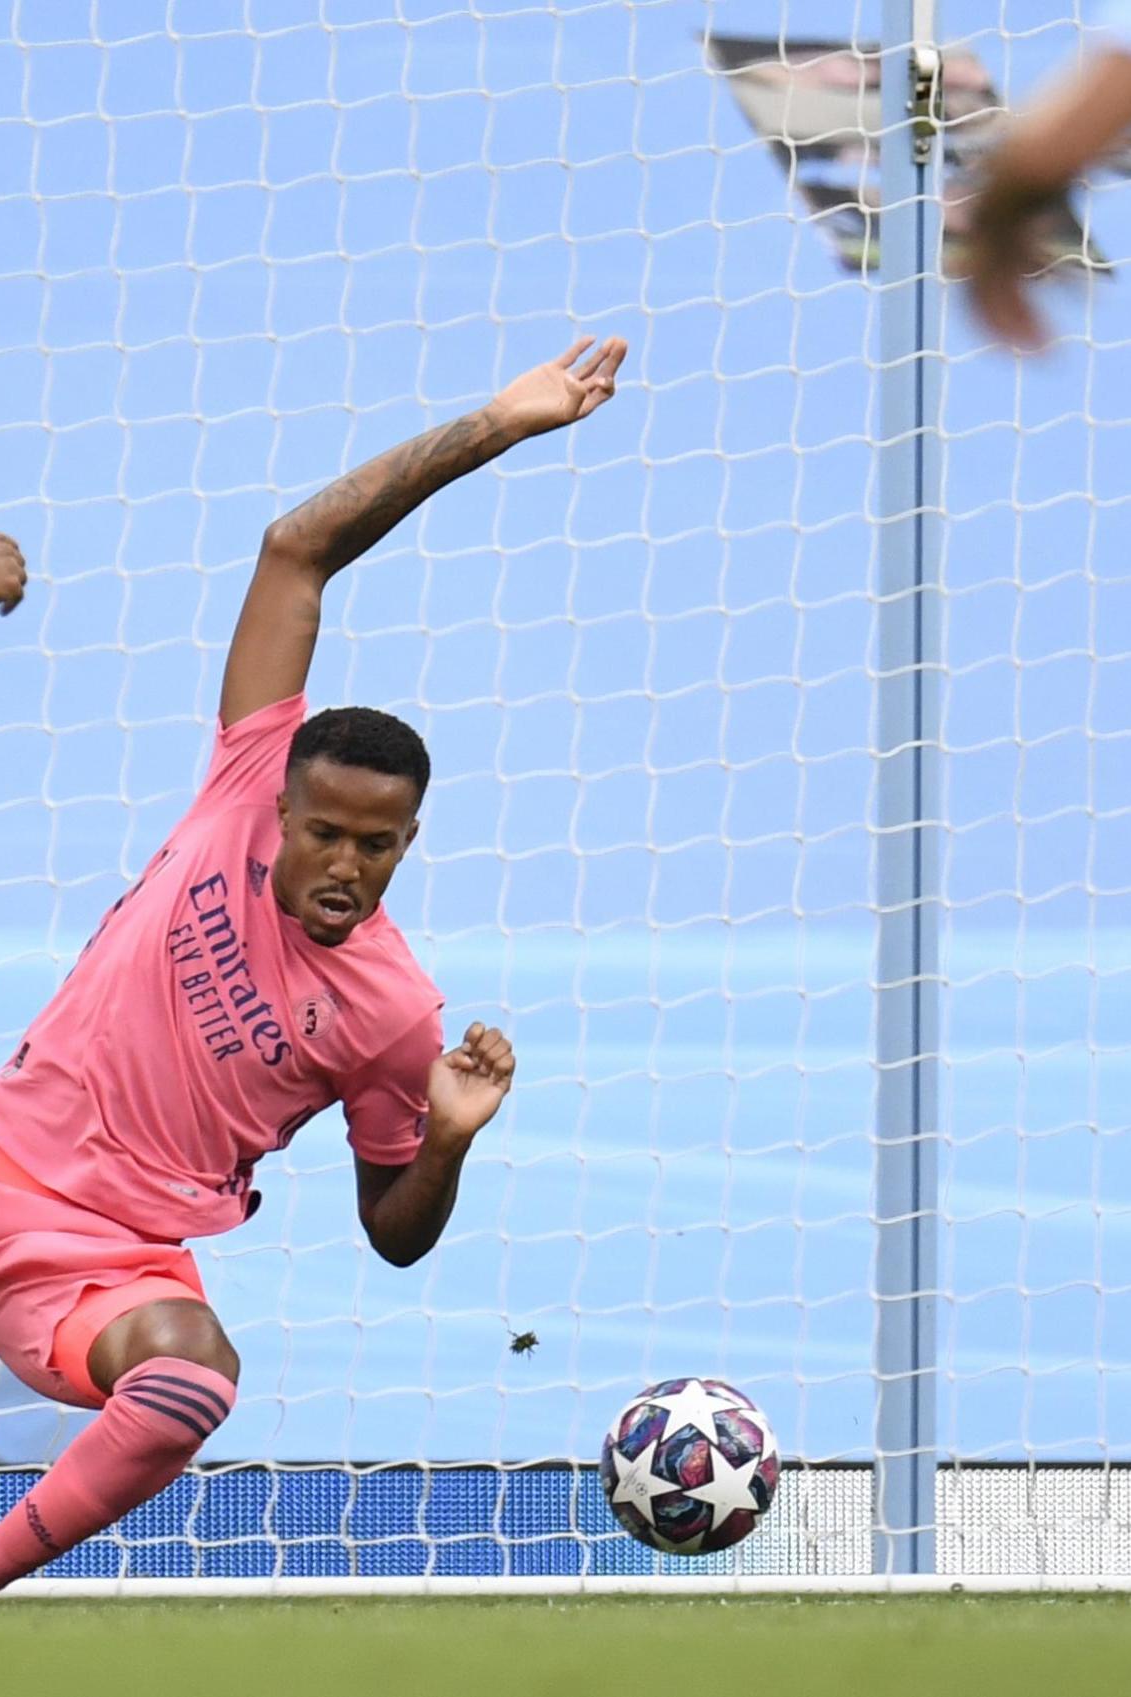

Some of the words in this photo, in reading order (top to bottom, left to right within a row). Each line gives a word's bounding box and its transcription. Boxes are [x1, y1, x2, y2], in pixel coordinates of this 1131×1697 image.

[169, 924, 203, 964] FLY
[189, 871, 292, 1066] Emirates
[181, 971, 244, 1061] BETTER
